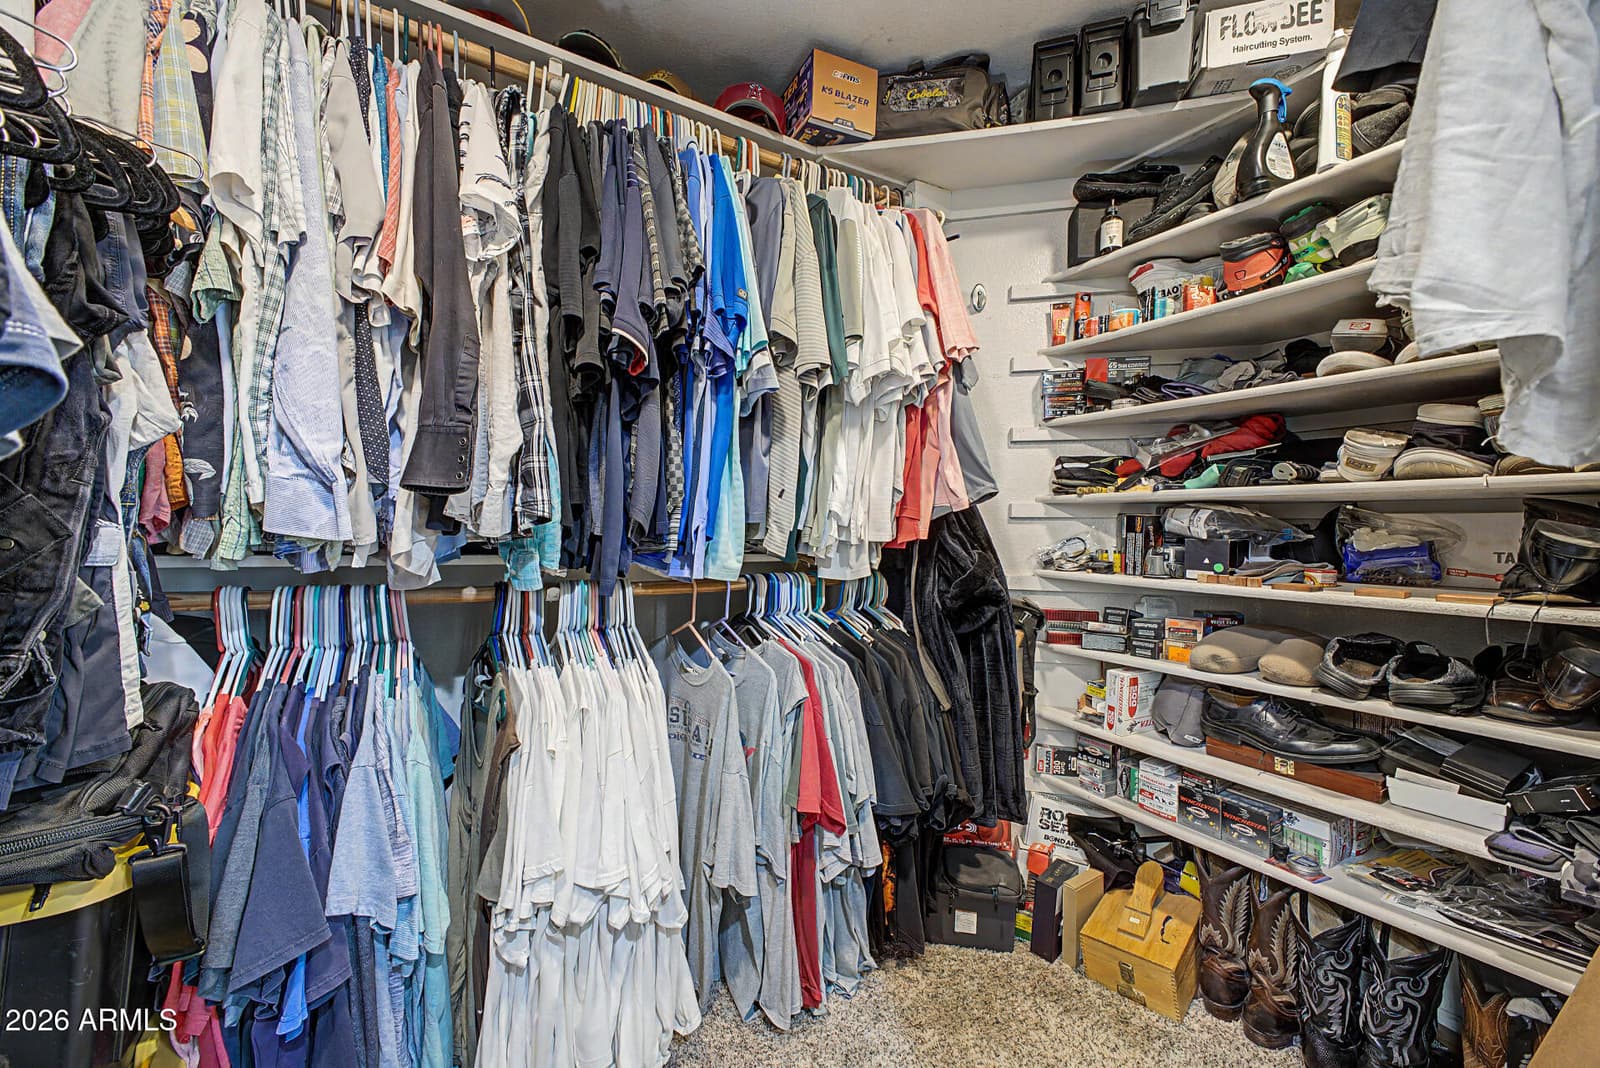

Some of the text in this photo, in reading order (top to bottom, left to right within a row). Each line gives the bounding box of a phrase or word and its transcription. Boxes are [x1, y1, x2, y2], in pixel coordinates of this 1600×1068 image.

[1232, 33, 1313, 53] Haircutting System.
[835, 90, 869, 107] BLAZER
[1180, 795, 1219, 814] WINCHESTER
[1223, 811, 1267, 831] WINCHESTER
